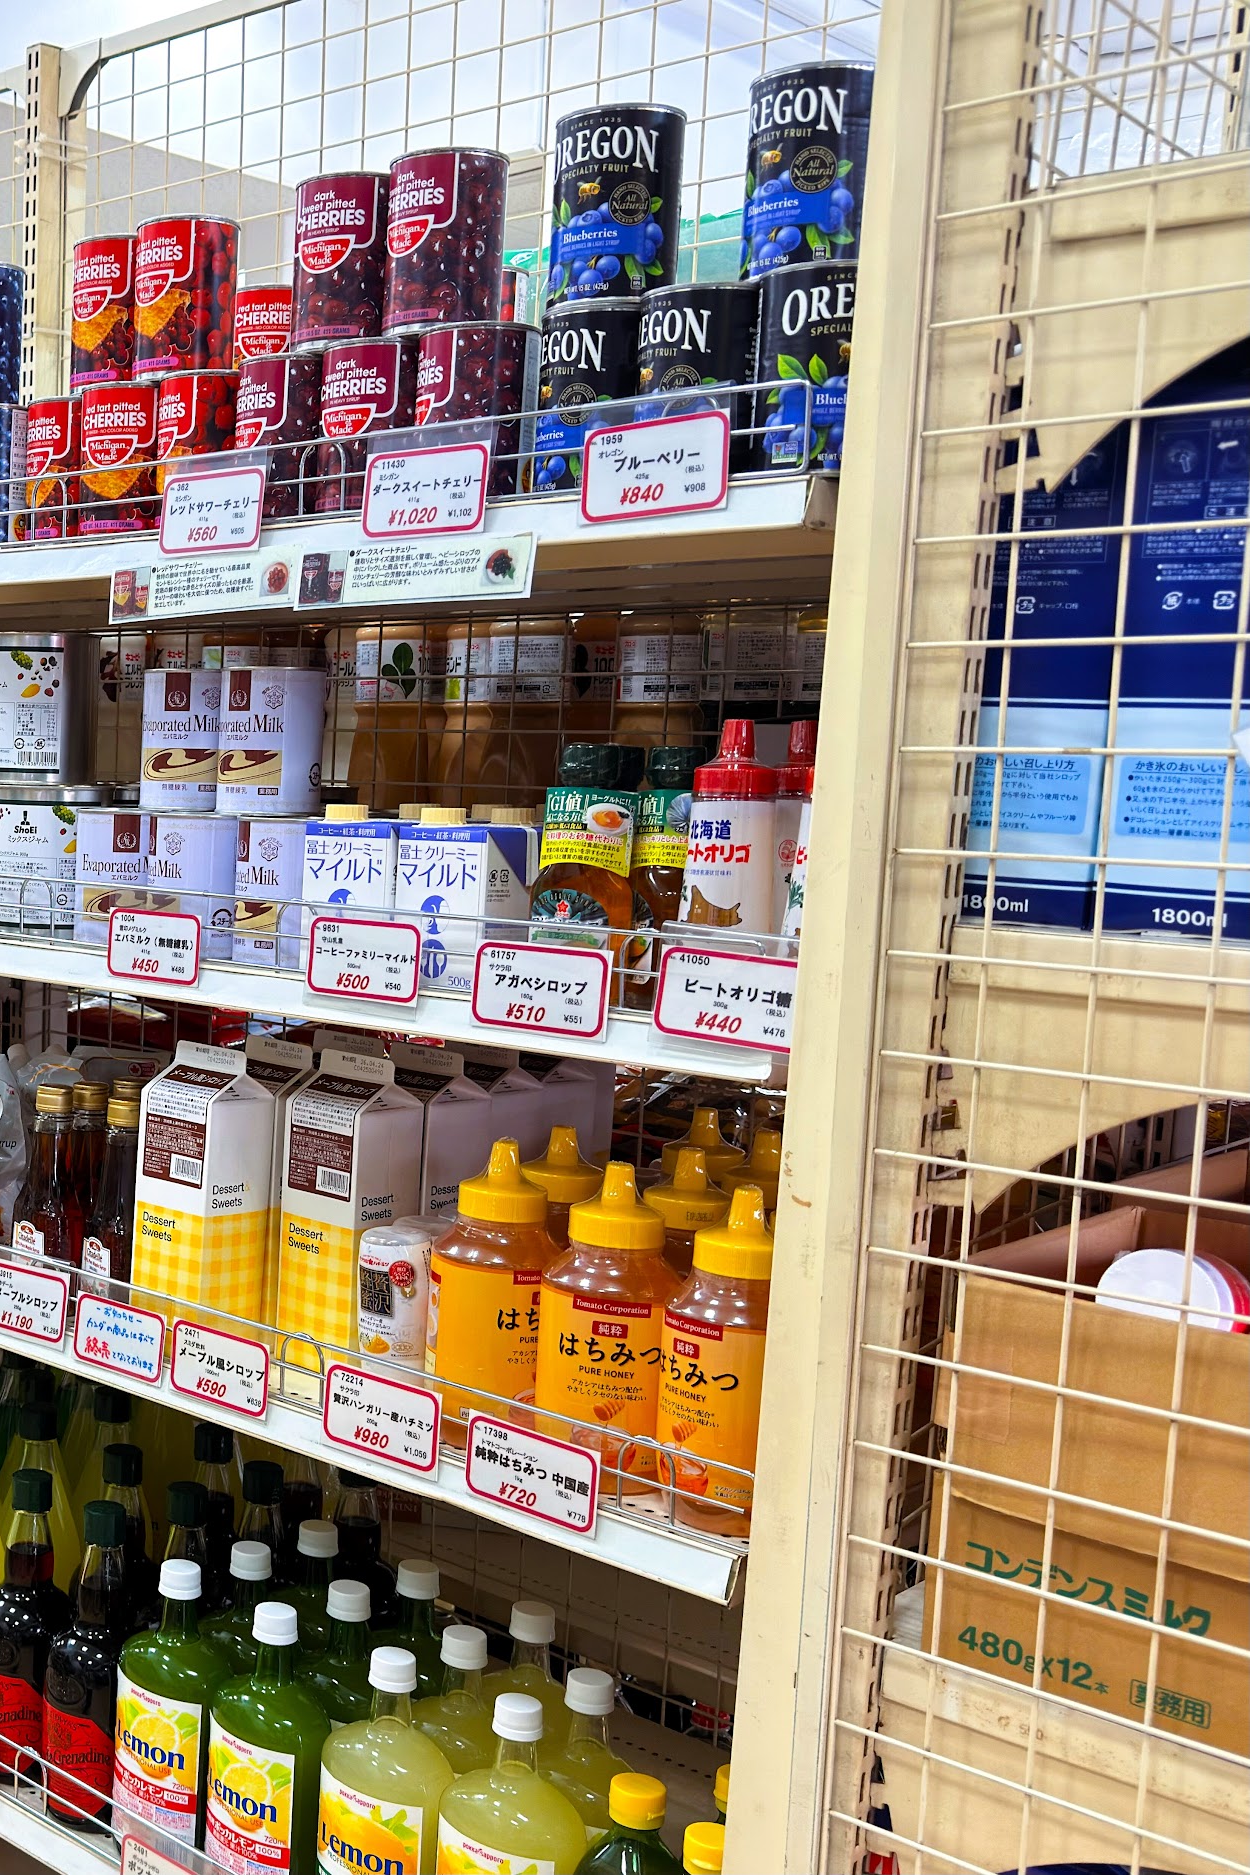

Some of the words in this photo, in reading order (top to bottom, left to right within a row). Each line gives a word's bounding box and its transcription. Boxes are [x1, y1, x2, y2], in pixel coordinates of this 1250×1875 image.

[750, 86, 848, 136] REGON
[784, 128, 812, 139] FRUIT
[398, 171, 415, 184] dark
[561, 165, 600, 183] SPECIALTY
[603, 163, 629, 173] FRUIT
[793, 164, 834, 177] Natural
[414, 178, 435, 190] pitted
[314, 190, 336, 201] dark
[326, 198, 356, 210] pitted
[611, 198, 648, 212] Natural
[296, 209, 365, 234] CHERRIES
[152, 235, 176, 247] pitted
[563, 228, 618, 242] Blueberries
[302, 241, 343, 254] Michigan
[308, 256, 333, 267] Made
[238, 304, 250, 312] red
[782, 282, 855, 337] ORE
[639, 307, 708, 353] EGON
[540, 328, 604, 371] EGON
[655, 347, 677, 358] FRUIT
[336, 359, 356, 371] dark
[321, 378, 387, 399] CHERRIES
[83, 412, 146, 430] CHERRIES
[600, 434, 623, 445] 1959
[598, 449, 624, 459] オレゴン
[613, 449, 701, 473] ブルーベリー
[382, 459, 405, 470] 11430
[177, 483, 189, 491] 362
[373, 478, 482, 496] ダークスイートチェリー
[620, 483, 663, 505] ¥840
[684, 482, 706, 493] ¥908
[170, 497, 259, 516] レッドサワーチェリー
[388, 506, 438, 527] ¥1,020
[447, 508, 472, 518] ¥1,102
[187, 525, 218, 543] ¥560
[252, 714, 284, 733] Milk
[975, 756, 1076, 771] のおしい召し上り方
[317, 826, 377, 838] コーヒー・紅茶・料理用
[411, 830, 470, 842] コーヒー・紅茶・料理用
[690, 819, 731, 840] 北海道
[688, 843, 751, 863] ートオリゴ
[82, 854, 141, 875] Evaporated
[307, 857, 383, 885] マイルド
[400, 862, 478, 891] マイルド
[120, 914, 135, 922] 1004
[322, 925, 340, 934] 9631
[315, 946, 417, 964] コーヒーファミリーマイルド
[490, 951, 516, 961] 61757
[679, 954, 710, 966] 41050
[132, 958, 159, 973] ¥450
[336, 972, 370, 991] ¥500
[384, 981, 401, 992] ¥540
[448, 975, 471, 988] 500g
[494, 973, 589, 995] アガベシロップ
[685, 978, 792, 1009] ビートオリゴ糖
[713, 1000, 728, 1009] 300g
[505, 1003, 545, 1023] ¥510
[563, 1014, 583, 1025] ¥551
[695, 1011, 742, 1033] ¥440
[763, 1025, 785, 1038] ¥476
[212, 1182, 245, 1196] Dessert
[211, 1197, 243, 1209] Sweets
[361, 1194, 394, 1208] Dessert
[142, 1211, 176, 1229] Dessert
[360, 1208, 392, 1222] Sweets
[141, 1224, 172, 1242] Sweets
[576, 1298, 604, 1312] Tomato
[605, 1302, 649, 1316] Corporation
[1, 1310, 33, 1330] ¥1,190
[184, 1327, 200, 1339] 2471
[597, 1323, 623, 1337] 純粋
[687, 1319, 720, 1337] Corporation
[84, 1336, 111, 1360] 終売
[184, 1339, 205, 1350] スミダ飲料
[559, 1332, 662, 1366] はちみつ
[676, 1341, 695, 1355] 純粋
[179, 1346, 265, 1381] メープル風シロップ
[340, 1372, 364, 1387] 72214
[578, 1365, 600, 1377] PURE
[602, 1368, 634, 1380] HONEY
[196, 1376, 226, 1398] ¥590
[684, 1387, 707, 1402] HONEY
[333, 1392, 434, 1433] 贅沢ハンガリー産ハチミツ
[483, 1426, 508, 1441] 17398
[354, 1425, 389, 1449] ¥980
[403, 1444, 427, 1460] ¥1,059
[481, 1438, 538, 1463] トマトコーポレーション
[474, 1444, 547, 1480] 純粋はちみつ
[552, 1472, 589, 1497] 中国産
[498, 1481, 537, 1507] ¥720
[567, 1509, 586, 1523] ¥778
[1134, 1683, 1208, 1727] 業務用
[165, 1793, 188, 1803] 100%
[257, 1845, 280, 1858] 100%
